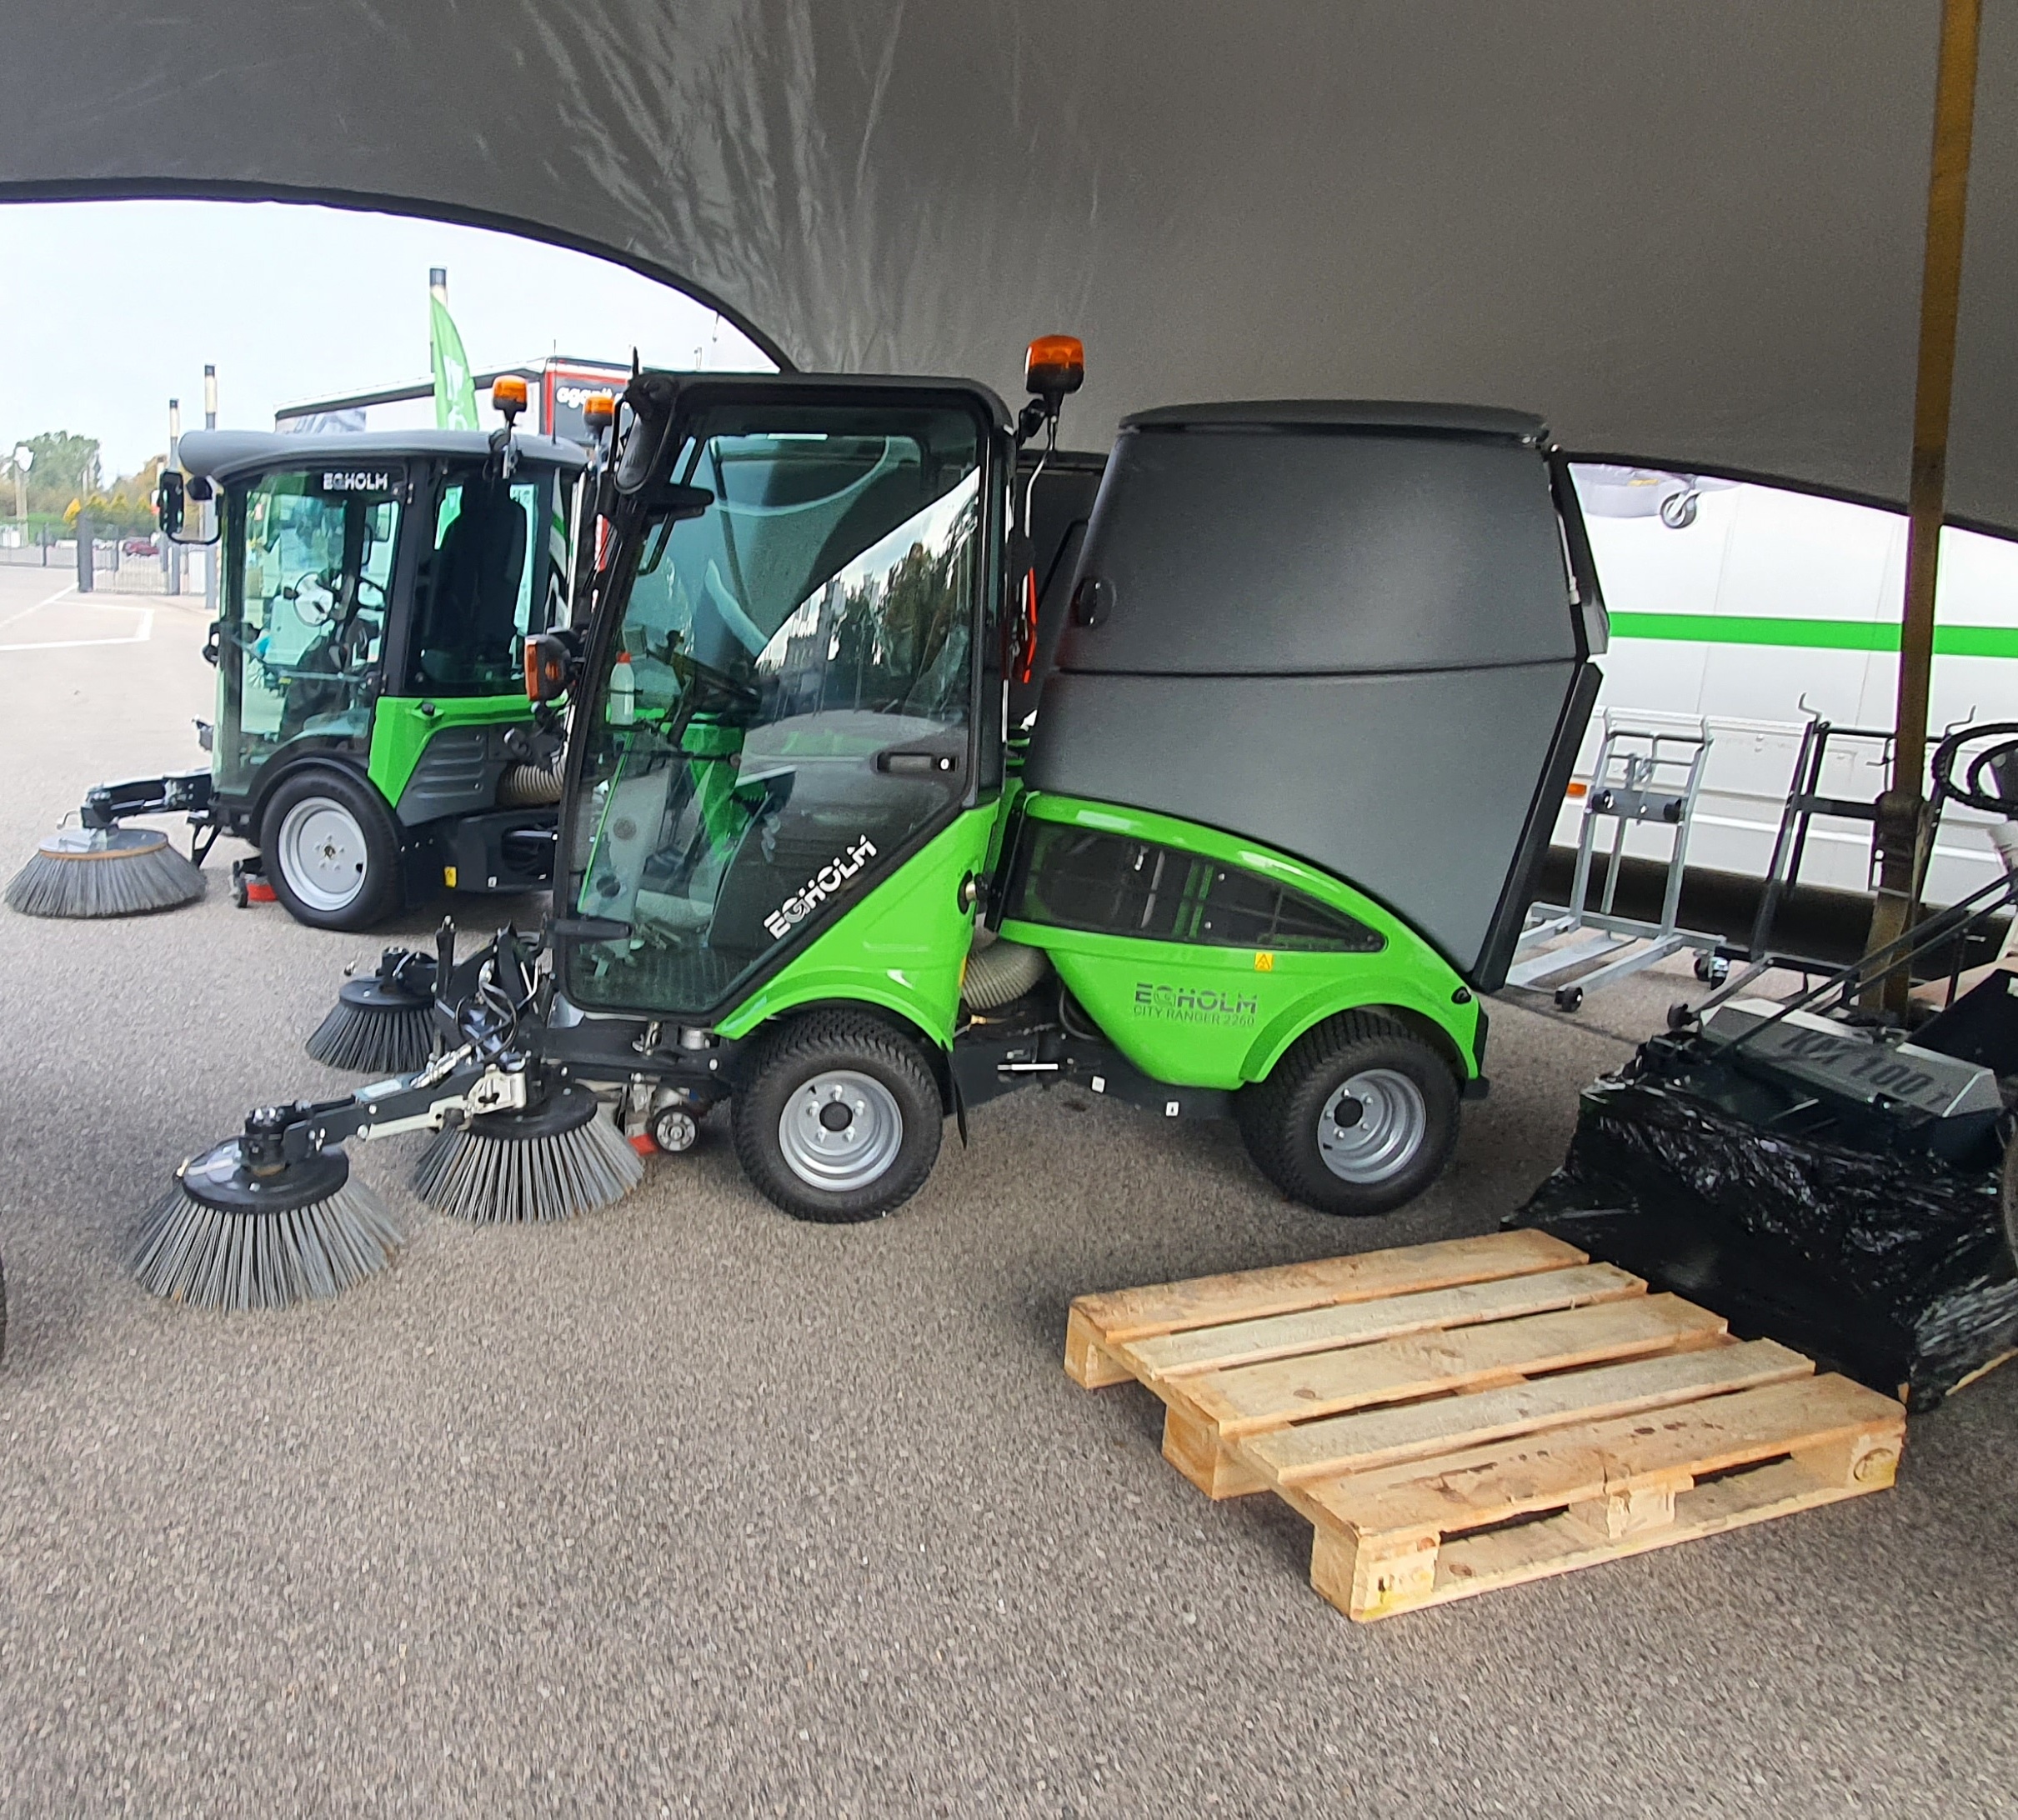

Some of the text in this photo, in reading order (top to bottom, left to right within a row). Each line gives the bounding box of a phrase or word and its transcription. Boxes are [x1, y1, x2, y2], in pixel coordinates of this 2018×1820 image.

[323, 472, 388, 491] EGHOLM
[763, 833, 878, 940] EGHOLM
[1133, 1004, 1163, 1018] CITY
[1166, 1008, 1220, 1026] RANGER
[1134, 982, 1258, 1015] EGHOLM
[1850, 1056, 1935, 1095] 100
